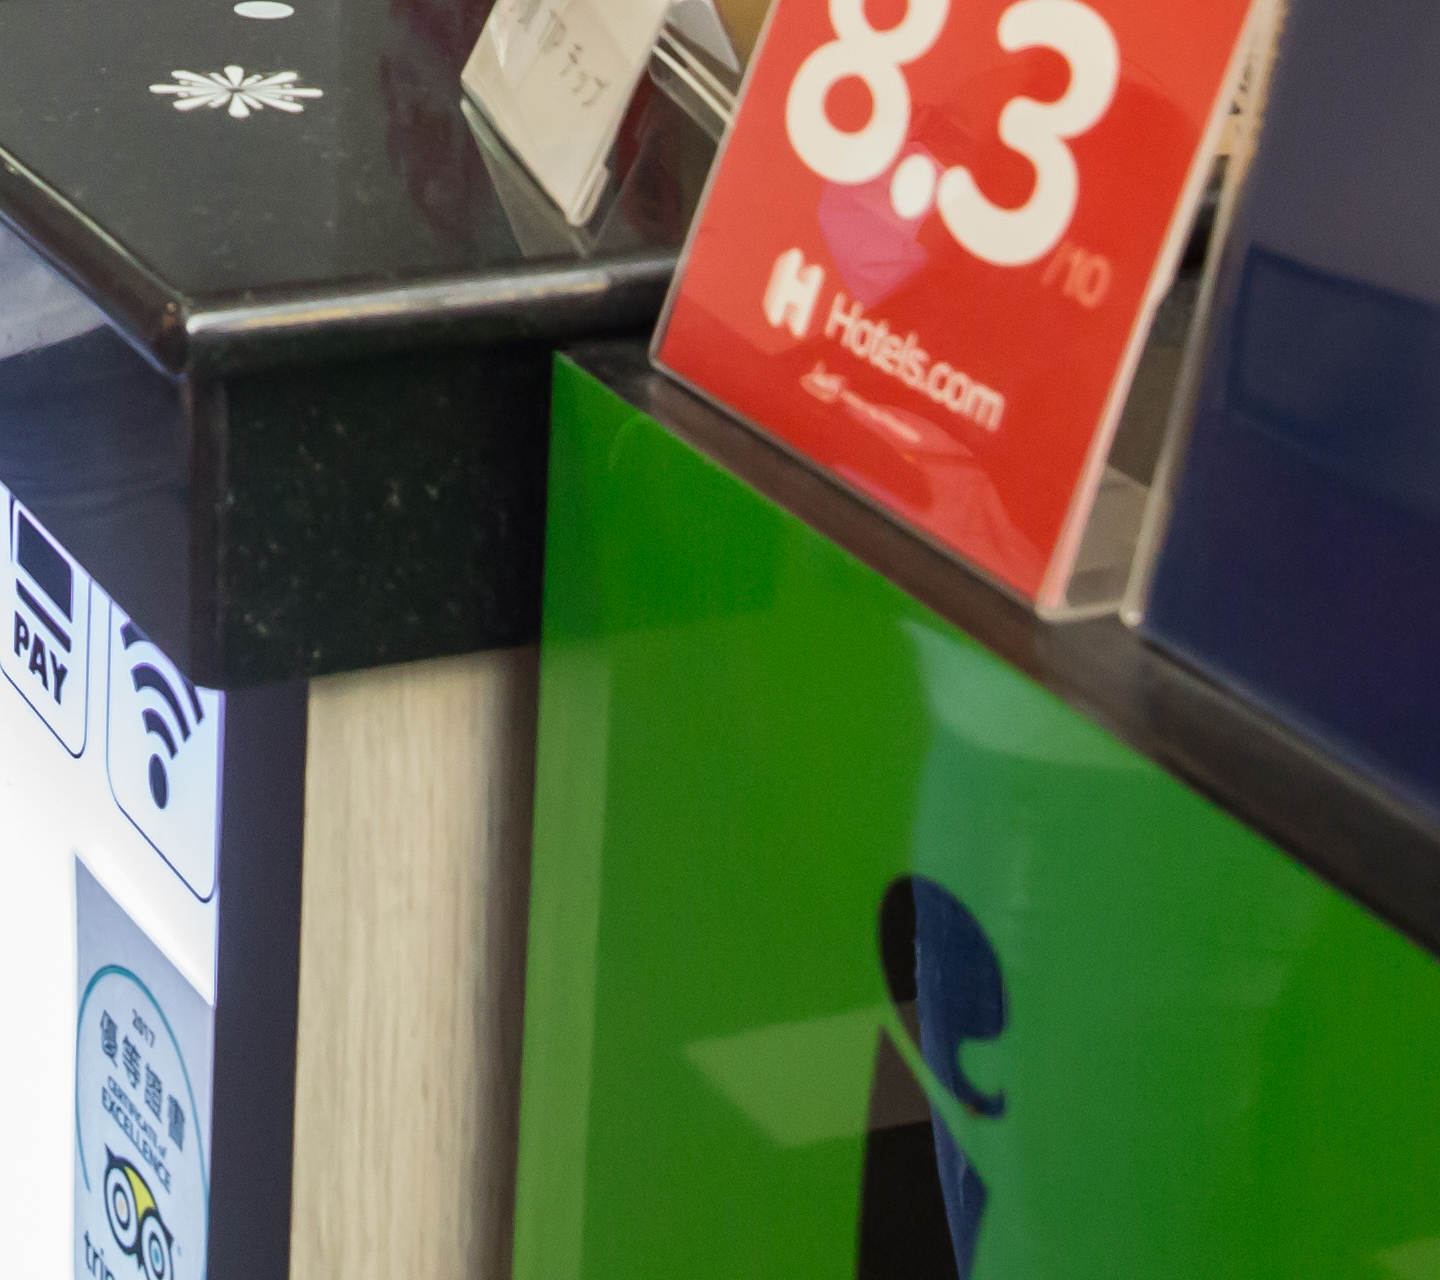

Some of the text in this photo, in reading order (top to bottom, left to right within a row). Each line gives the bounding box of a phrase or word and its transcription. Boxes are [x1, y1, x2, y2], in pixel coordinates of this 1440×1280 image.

[823, 291, 1008, 433] Hotels.com
[13, 609, 69, 706] PAY
[101, 1085, 172, 1196] EXCELLENCE
